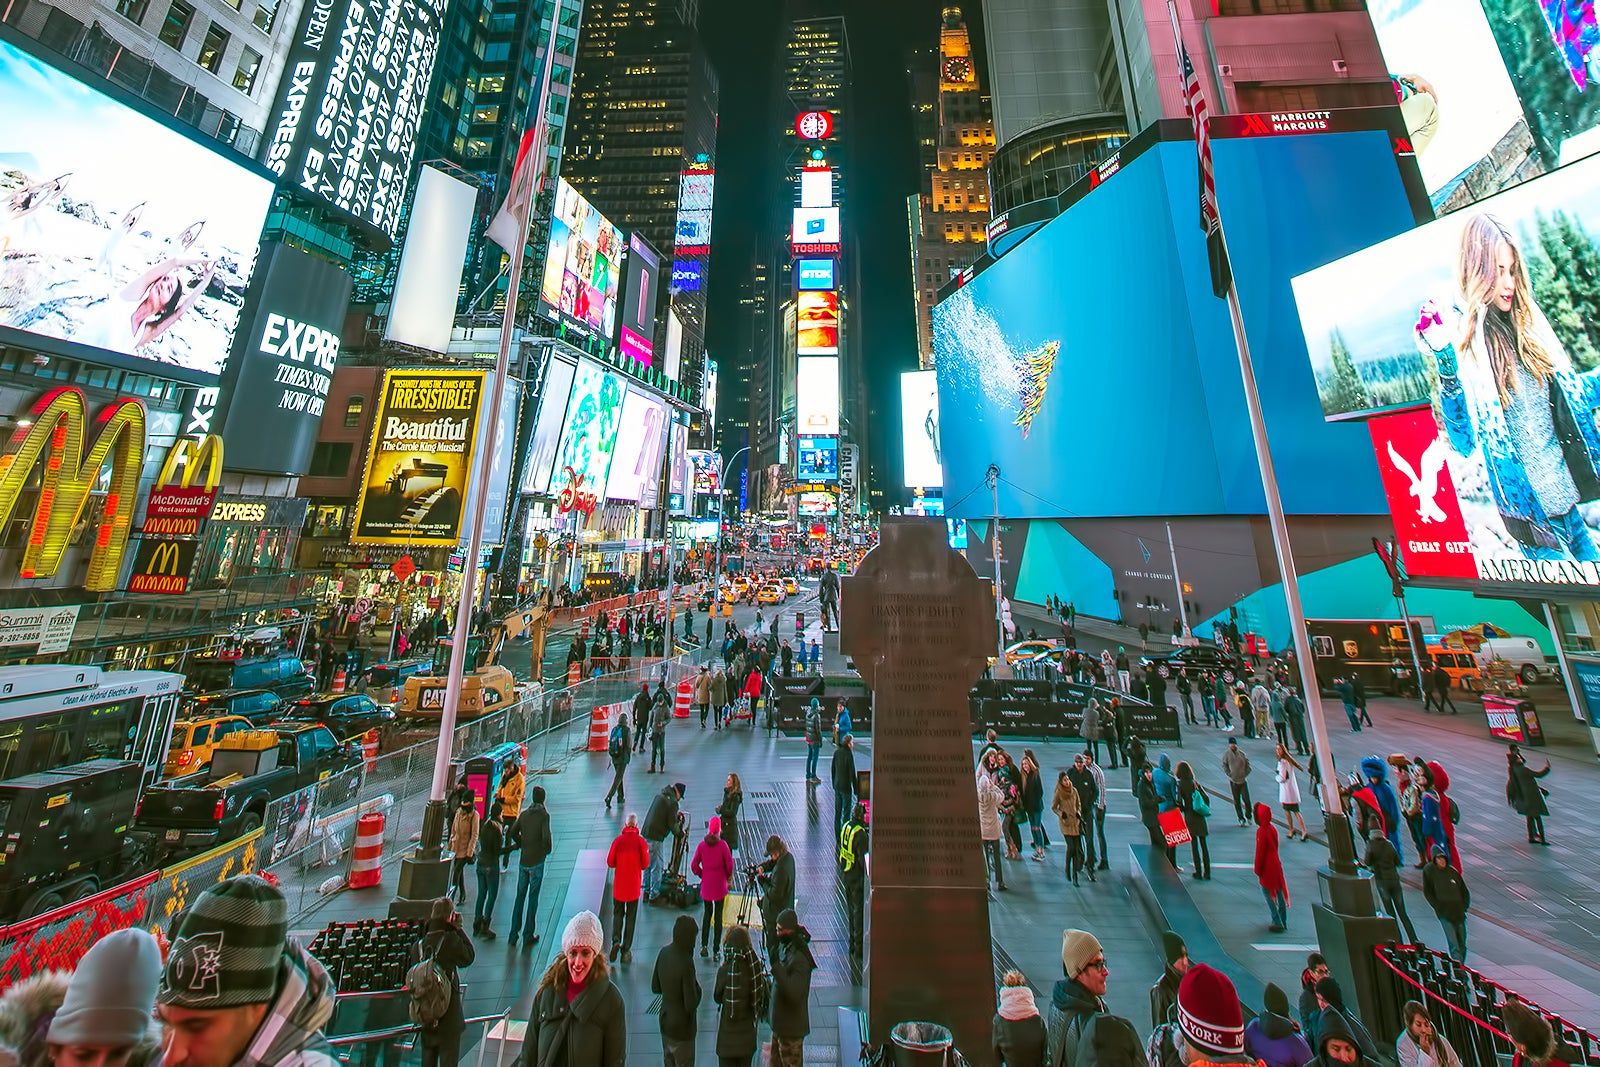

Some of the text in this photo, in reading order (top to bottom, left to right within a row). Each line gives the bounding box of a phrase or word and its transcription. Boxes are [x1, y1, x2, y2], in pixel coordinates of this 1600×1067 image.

[316, 0, 365, 140] EXPRESS
[386, 28, 425, 154] EXPRESS
[265, 62, 316, 177] EXPRESS
[1271, 111, 1330, 122] MARRIOTT
[1273, 121, 1327, 131] MARQUIS
[793, 244, 839, 253] TOSHIBA
[274, 362, 313, 389] TIMES
[278, 389, 310, 412] NOW
[383, 416, 469, 441] Beautiful
[382, 441, 465, 454] The Carole King Musical
[150, 495, 210, 506] McDonald's
[211, 502, 267, 522] EXPRESS
[1408, 541, 1441, 553] GREAT
[1481, 558, 1588, 585] AMERICAN
[1, 613, 44, 627] Summit
[62, 686, 139, 705] Clean Air Hybrid Electric Bus
[421, 689, 447, 708] CAT
[1189, 1021, 1222, 1045] YORK
